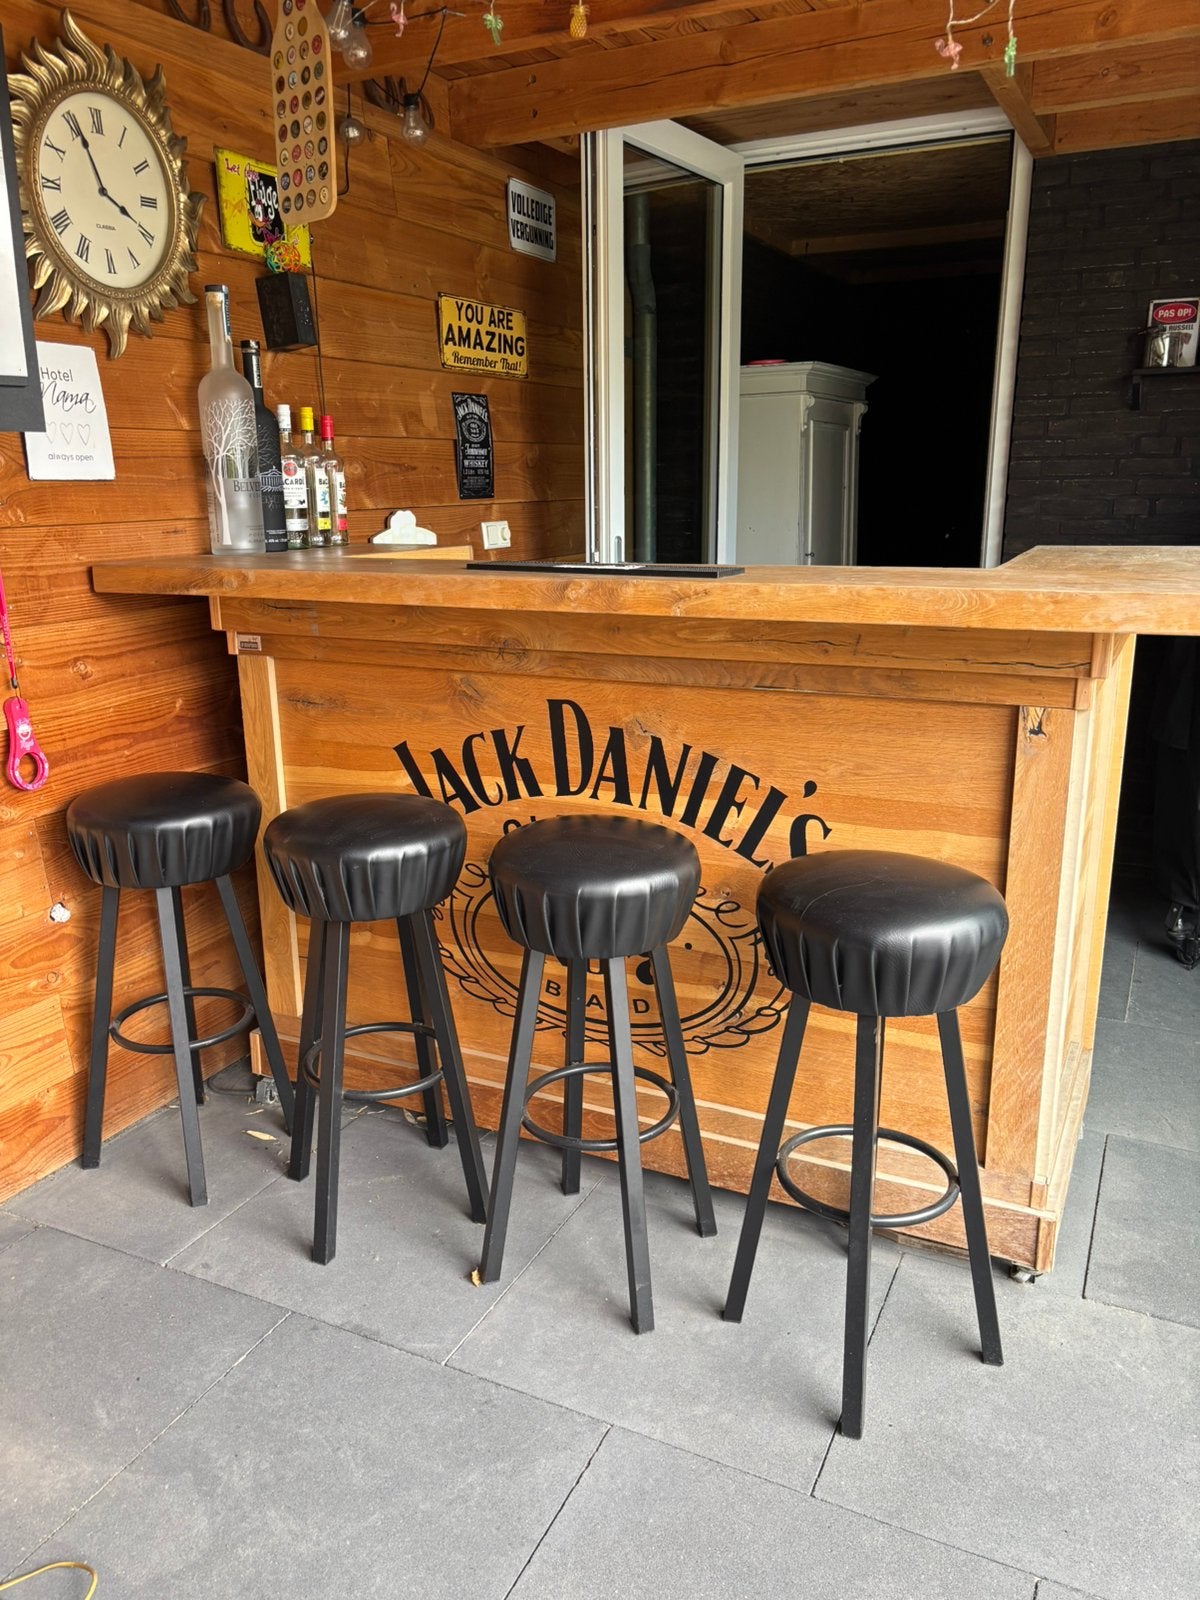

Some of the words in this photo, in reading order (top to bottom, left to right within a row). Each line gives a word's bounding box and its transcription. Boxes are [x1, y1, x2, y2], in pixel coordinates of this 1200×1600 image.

[511, 190, 553, 227] VOLLEDIGE
[510, 218, 554, 250] VERGUNNING
[455, 300, 484, 326] YOU
[488, 307, 514, 331] ARE
[1158, 309, 1175, 319] PAS
[1177, 308, 1192, 318] OP!
[444, 322, 525, 357] AMAZING
[40, 366, 74, 383] Hotel
[452, 350, 498, 369] Remember
[500, 357, 522, 372] That!
[48, 452, 74, 463] always
[75, 454, 95, 463] open
[393, 725, 544, 815] JACK
[546, 698, 832, 870] DANIEL'S
[545, 979, 650, 1014] BAD
